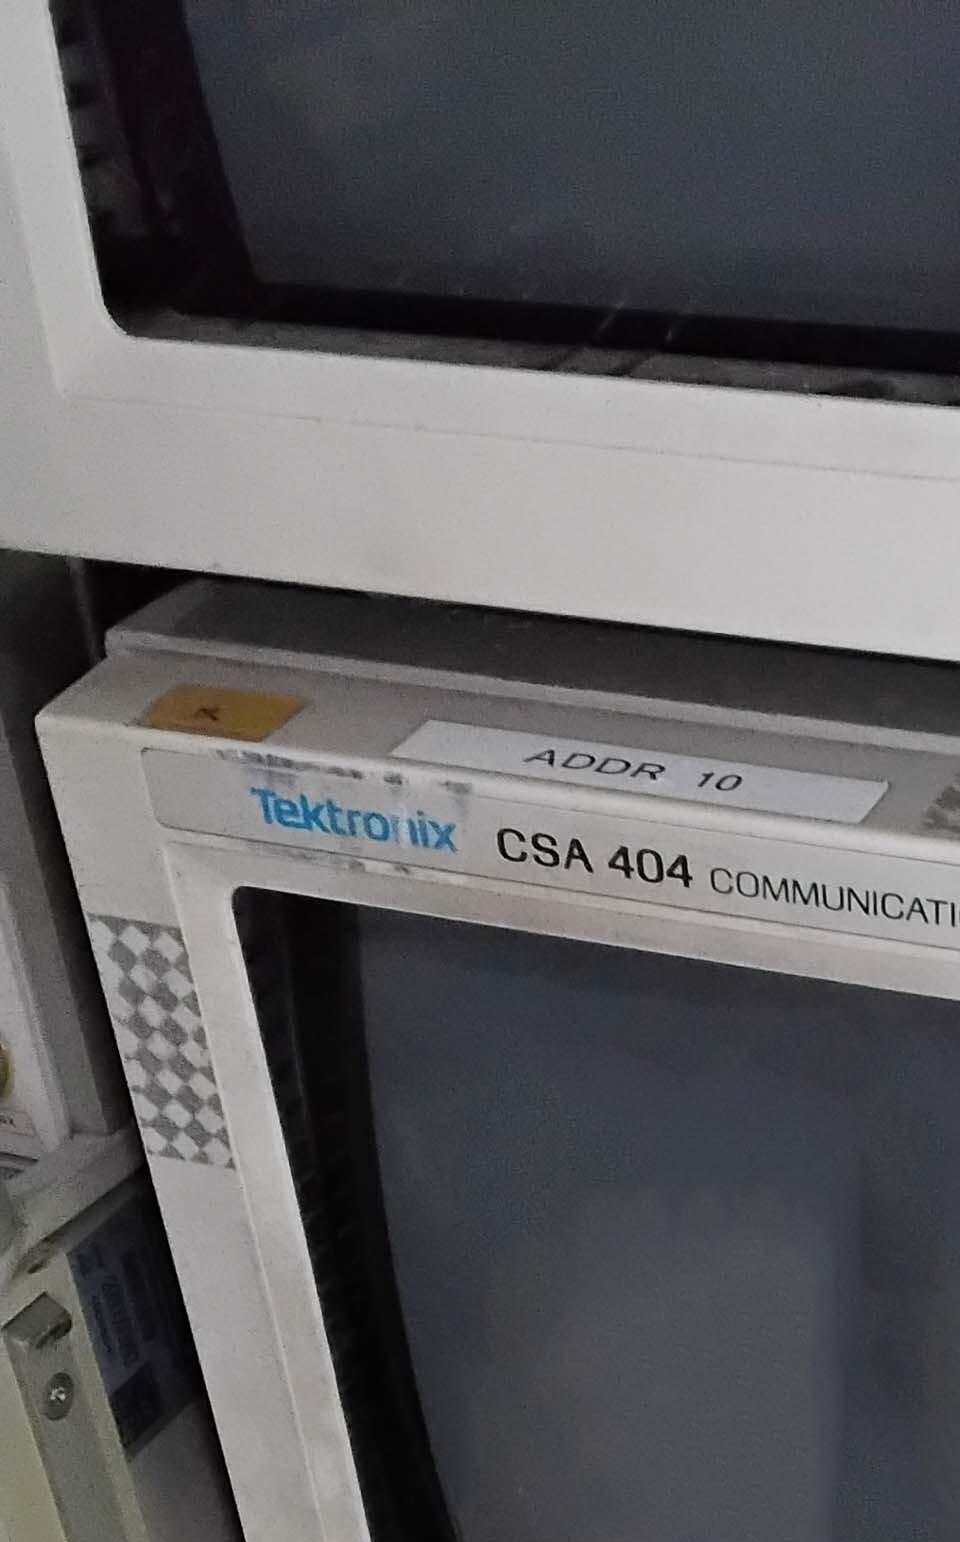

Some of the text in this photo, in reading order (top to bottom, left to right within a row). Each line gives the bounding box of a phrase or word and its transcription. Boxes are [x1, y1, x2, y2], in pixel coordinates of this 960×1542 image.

[523, 748, 744, 793] ADDR 10
[497, 828, 593, 875] CSA
[608, 845, 694, 889] 404
